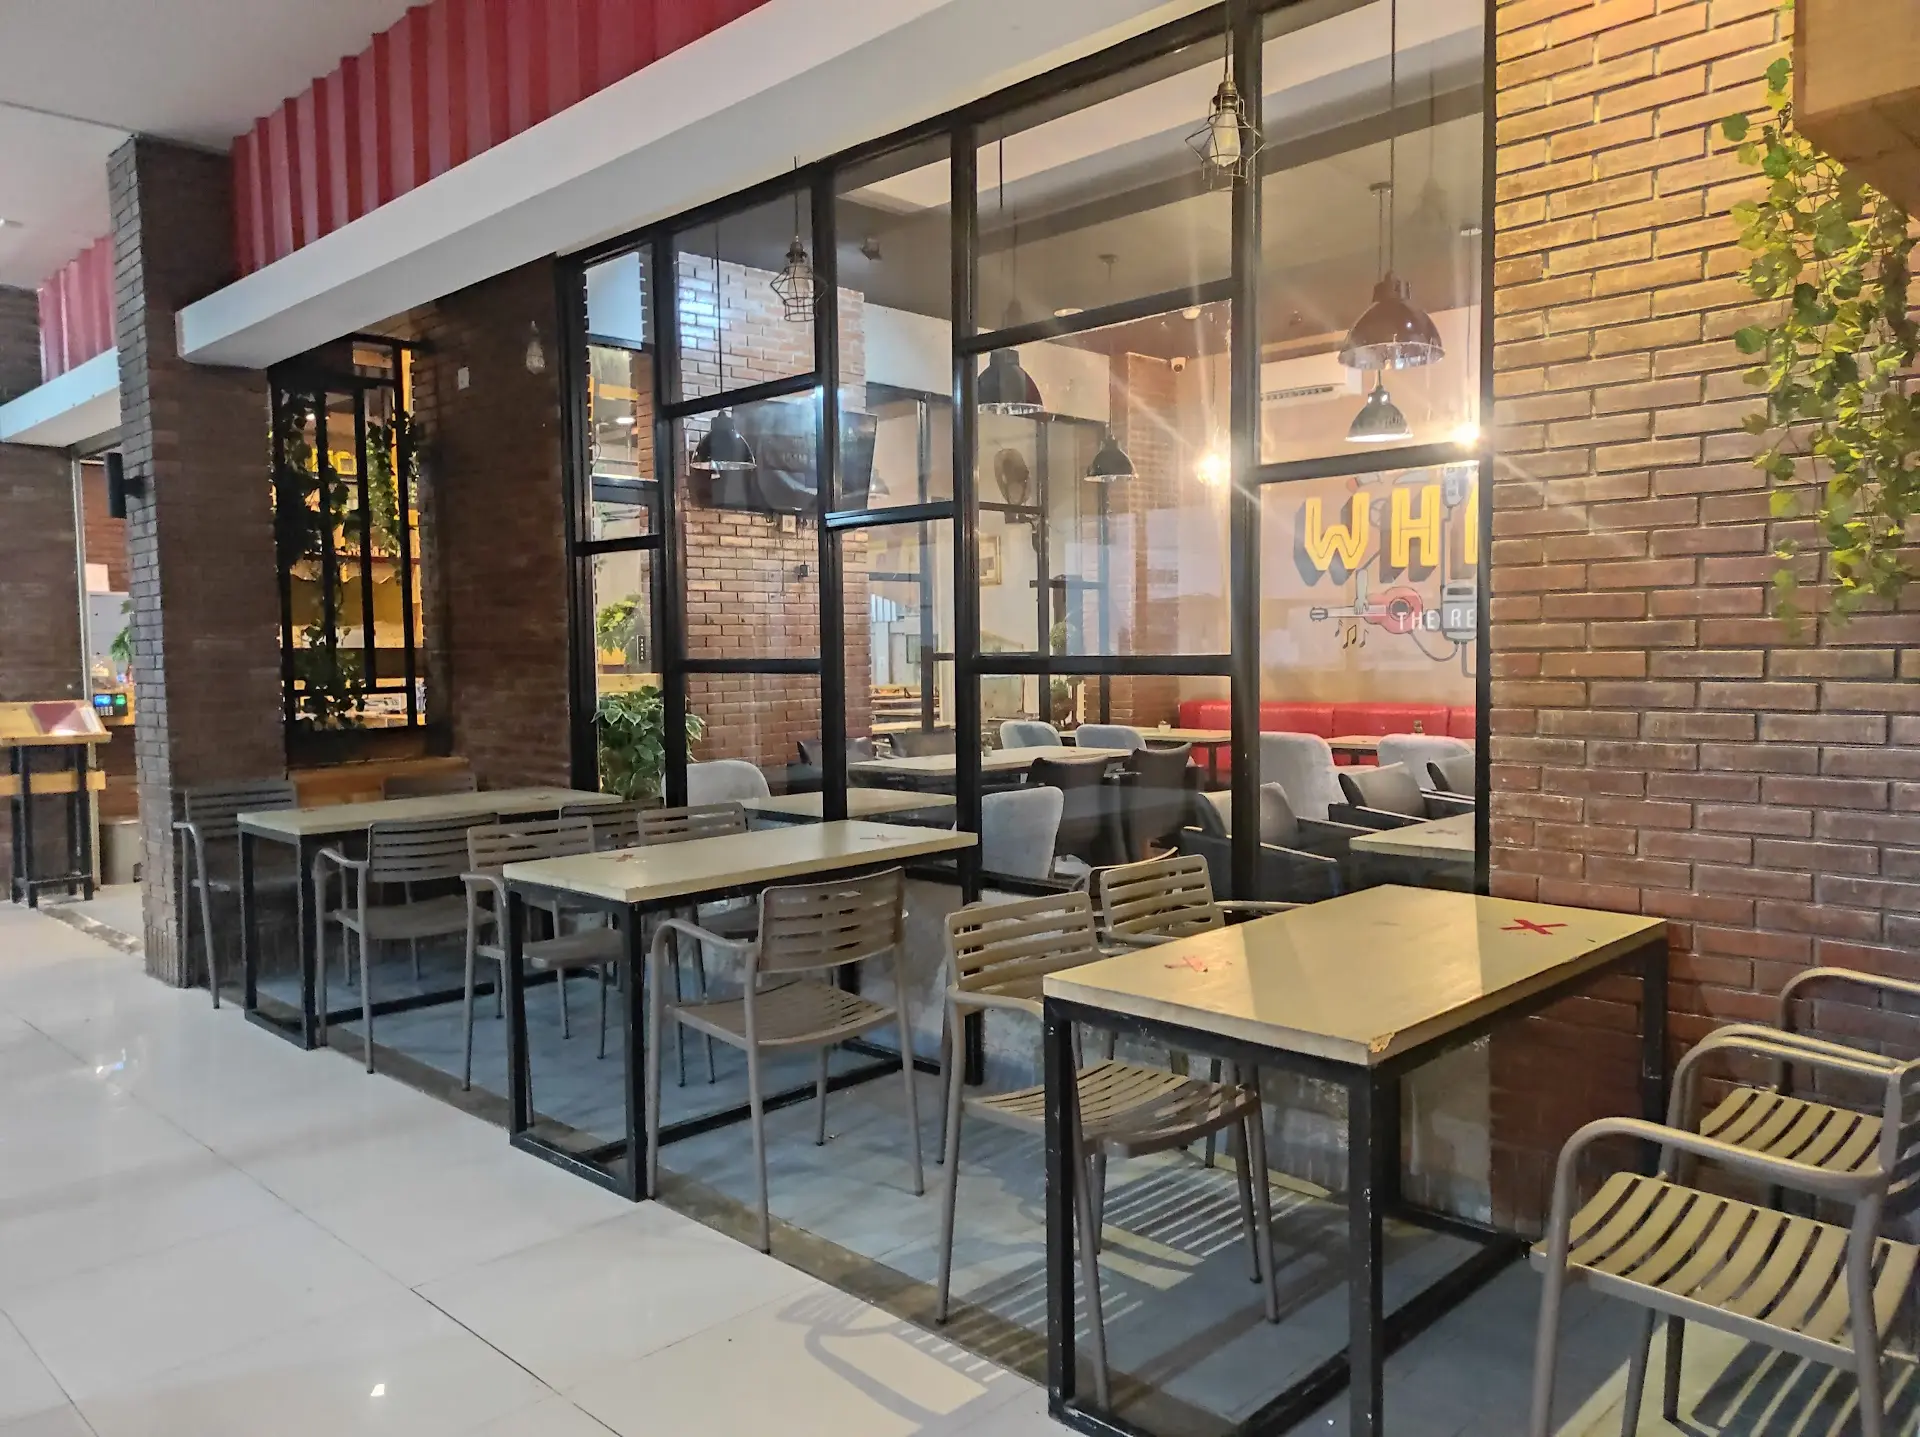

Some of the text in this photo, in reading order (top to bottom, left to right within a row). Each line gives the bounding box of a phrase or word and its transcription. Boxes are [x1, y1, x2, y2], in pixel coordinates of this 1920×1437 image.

[1301, 483, 1479, 572] WH
[1396, 607, 1476, 631] THE RE
